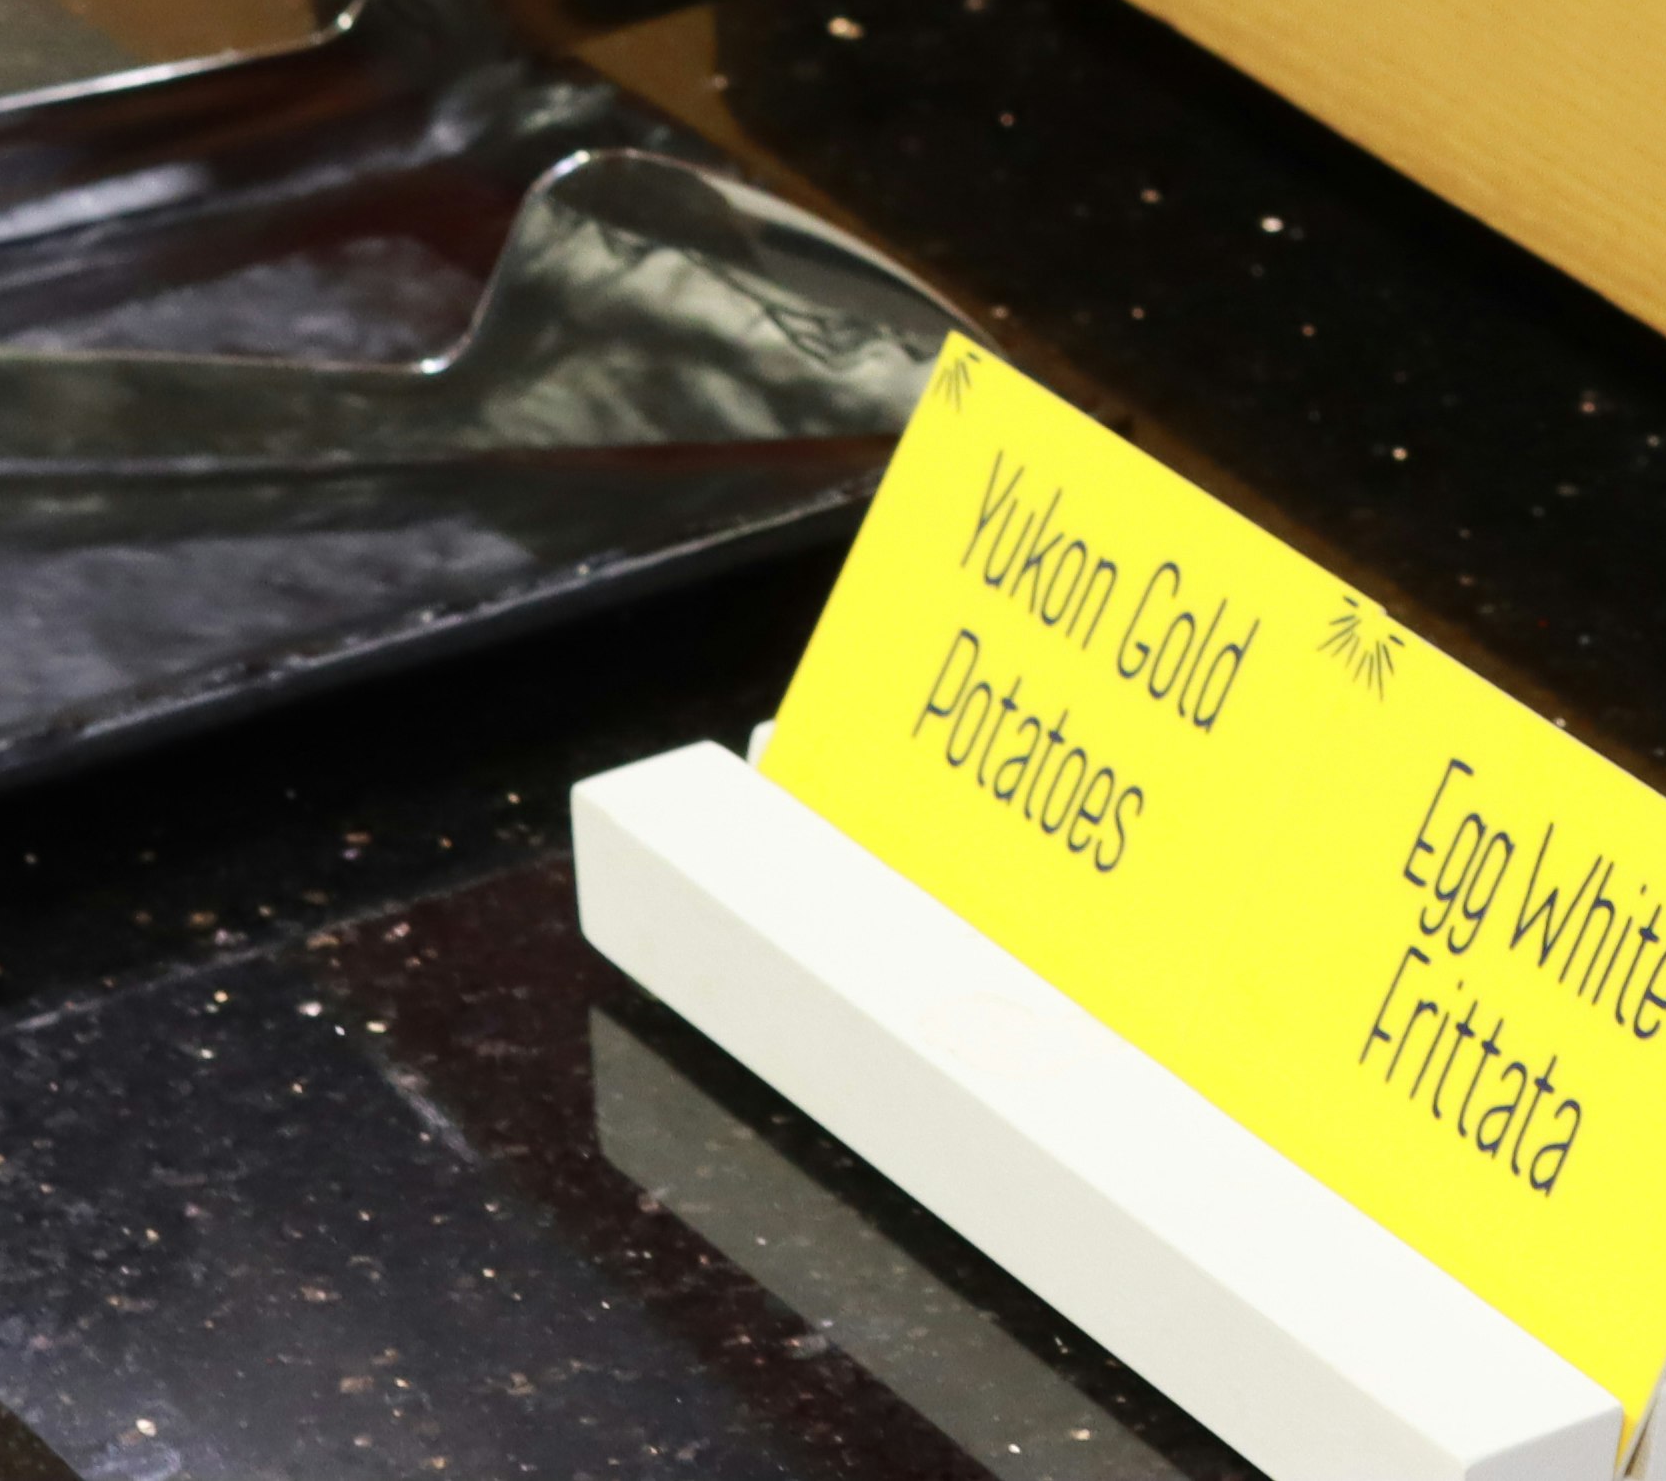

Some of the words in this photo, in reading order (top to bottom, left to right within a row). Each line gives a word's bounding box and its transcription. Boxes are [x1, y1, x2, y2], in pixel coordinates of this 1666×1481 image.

[960, 449, 1119, 652] Yukon
[1118, 562, 1258, 734] Gold
[912, 628, 1144, 872] Potatoes
[1404, 758, 1514, 954] Egg
[1358, 947, 1582, 1196] Frittata
